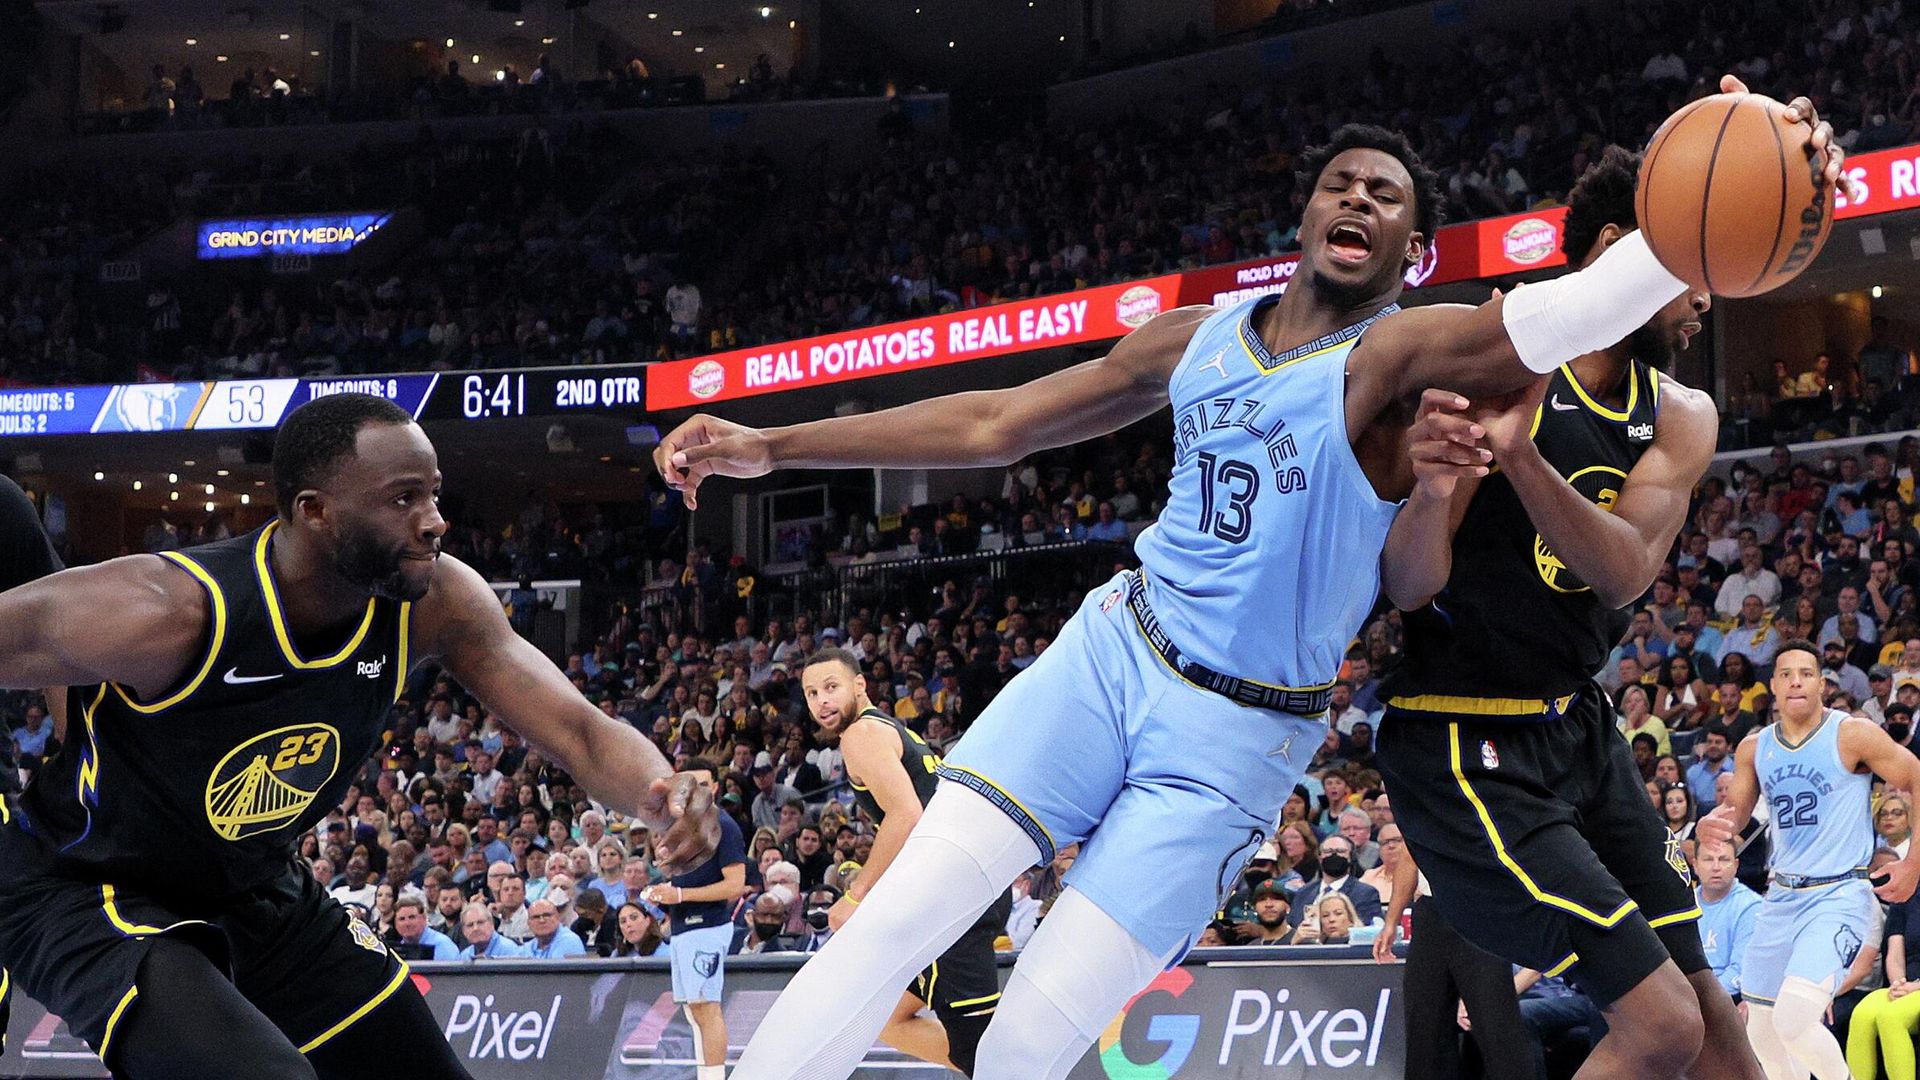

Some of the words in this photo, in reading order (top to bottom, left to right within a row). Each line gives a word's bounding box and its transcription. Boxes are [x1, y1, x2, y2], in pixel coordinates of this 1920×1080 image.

[208, 231, 258, 249] GRIND
[260, 228, 301, 246] CITY
[302, 227, 355, 245] MEDIA
[1236, 265, 1272, 285] PROUD
[746, 356, 803, 388] REAL
[809, 327, 935, 377] POTATOES
[949, 314, 1012, 354] REAL
[1019, 300, 1088, 342] EASY
[64, 391, 75, 411] 5
[228, 385, 265, 423] 53
[387, 378, 398, 399] 6
[463, 373, 524, 418] 6:41
[556, 379, 596, 406] 2ND
[601, 377, 640, 407] QTR
[37, 413, 48, 433] 2
[1197, 450, 1259, 544] 13
[272, 732, 330, 771] 23
[1773, 791, 1818, 829] 22
[445, 994, 562, 1060] Pixel
[1218, 988, 1391, 1068] Pixel
